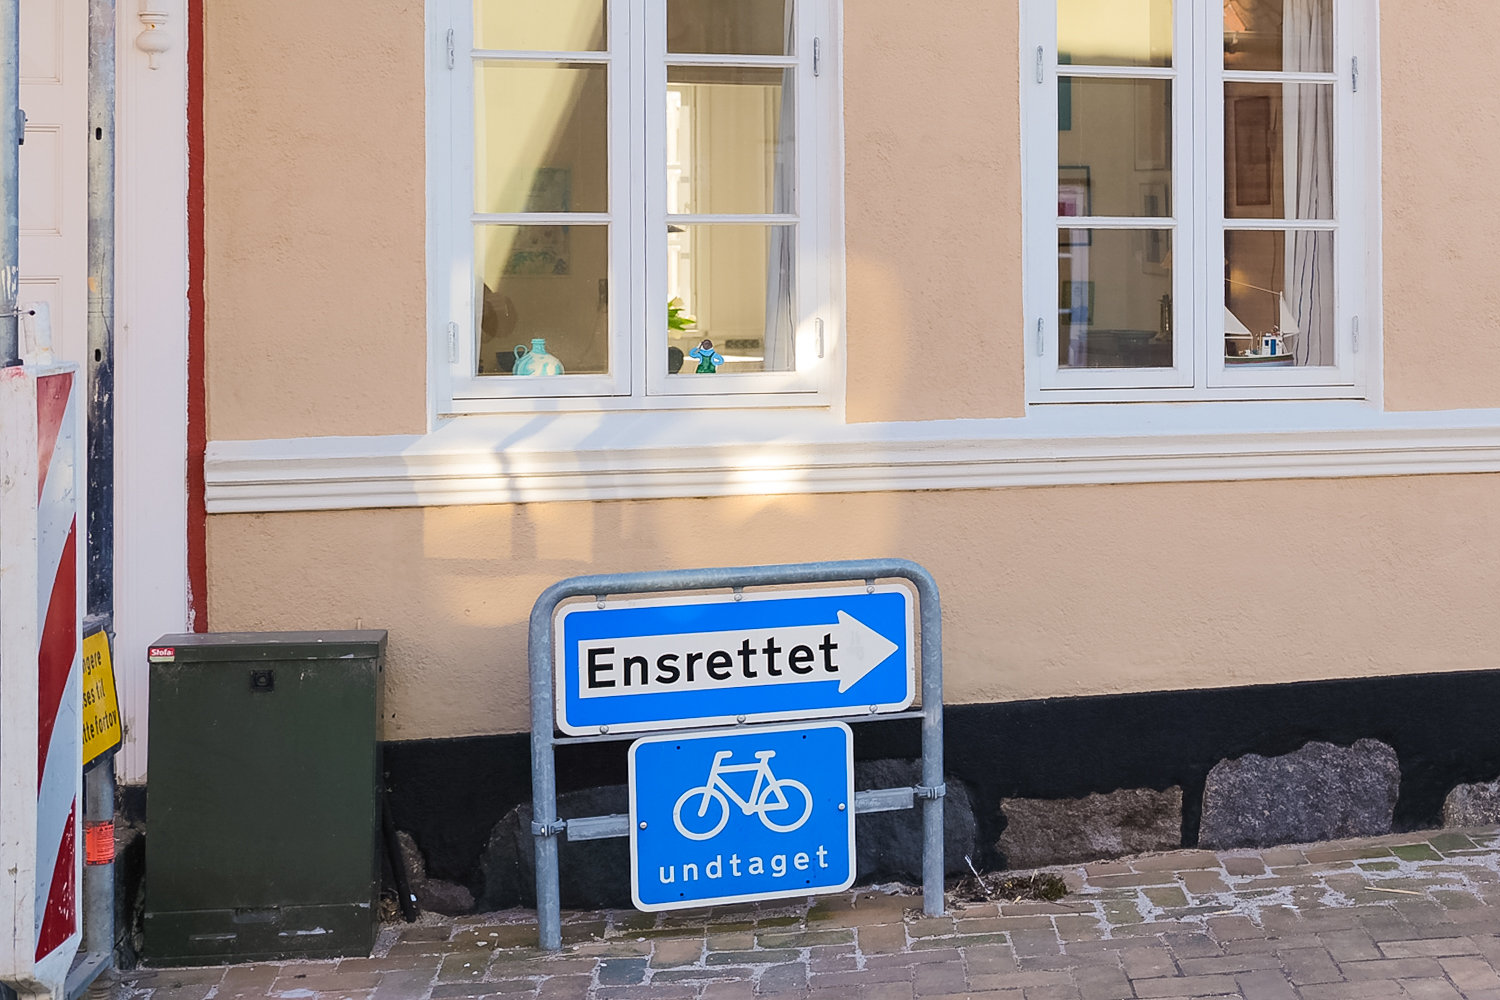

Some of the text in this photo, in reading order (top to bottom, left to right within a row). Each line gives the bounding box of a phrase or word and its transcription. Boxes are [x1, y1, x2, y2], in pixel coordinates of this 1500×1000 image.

[586, 632, 839, 689] Ensrettet
[82, 677, 106, 709] ses til
[82, 709, 117, 745] tte fortov
[659, 844, 829, 884] undtaget
